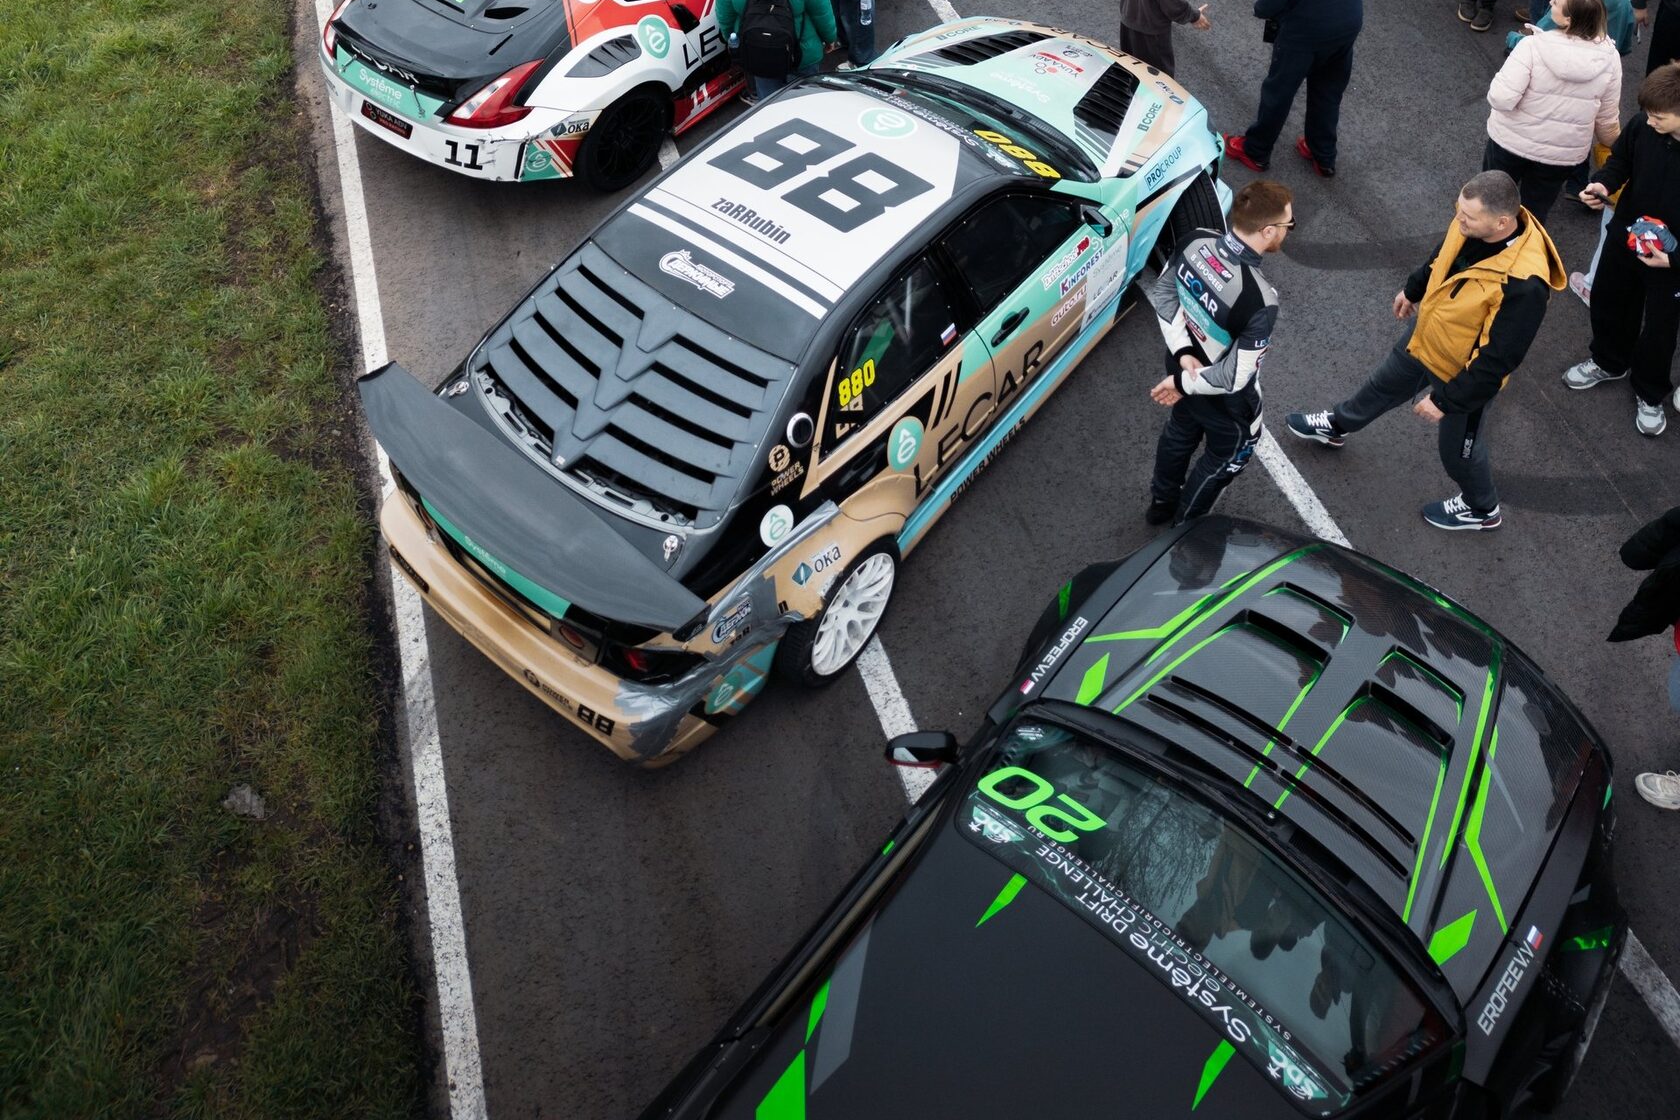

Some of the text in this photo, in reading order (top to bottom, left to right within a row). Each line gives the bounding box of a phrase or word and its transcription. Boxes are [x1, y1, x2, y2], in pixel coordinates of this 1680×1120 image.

[359, 68, 403, 101] Système
[445, 140, 483, 171] 11
[706, 118, 936, 233] 88
[974, 129, 1062, 179] 880
[711, 197, 792, 245] zaRRubin
[1061, 248, 1104, 296] KINFOREST
[1177, 263, 1219, 317] LECAR
[1196, 260, 1224, 292] ЕРОФЕЕВ
[1052, 284, 1088, 325] auto.ru
[838, 358, 876, 408] 880
[911, 339, 1045, 500] LECAR
[769, 460, 801, 487] POWER
[769, 468, 804, 497] WHEELS
[577, 703, 615, 737] 88
[977, 766, 1108, 843] 20
[1035, 844, 1222, 994] electric CHALLENGE
[1075, 891, 1252, 1043] Système DRIFT
